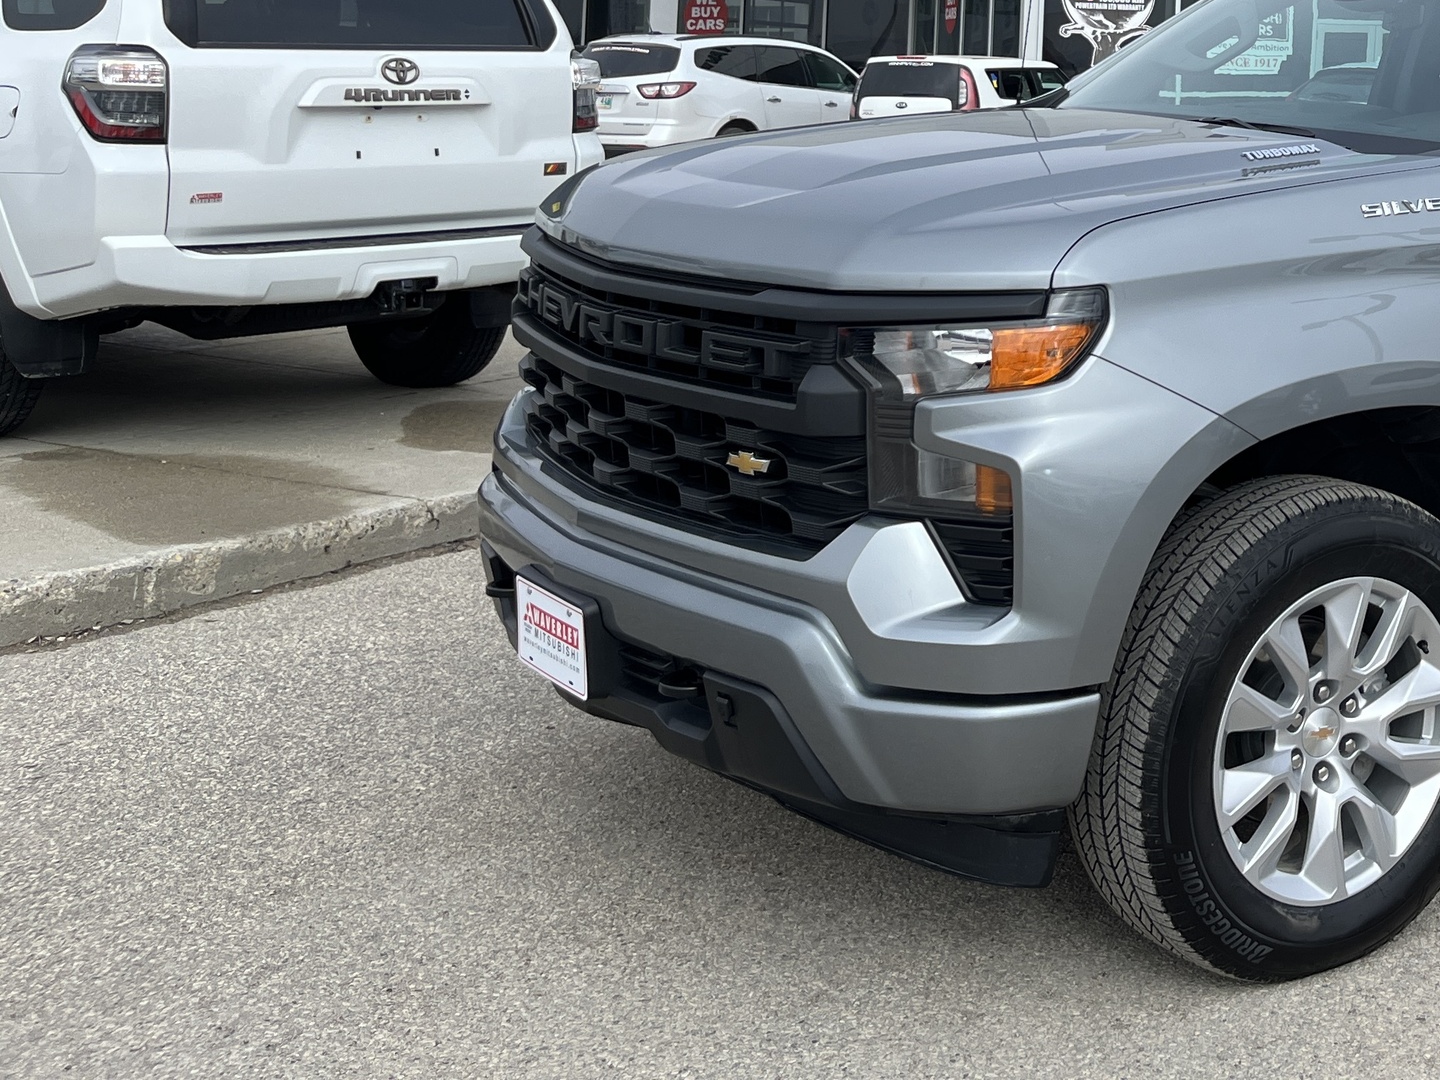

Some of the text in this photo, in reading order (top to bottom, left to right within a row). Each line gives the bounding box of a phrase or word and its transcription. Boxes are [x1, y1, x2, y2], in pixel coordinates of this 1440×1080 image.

[686, 19, 725, 31] CARS
[691, 6, 721, 18] BUY
[1254, 58, 1279, 68] 1917
[1241, 143, 1321, 162] TURBOMAX
[518, 268, 811, 378] CHEVROLET
[532, 607, 579, 649] WAVERLEY
[534, 627, 579, 662] MITSUBISHI
[1173, 849, 1275, 964] BRIDGESTONE
